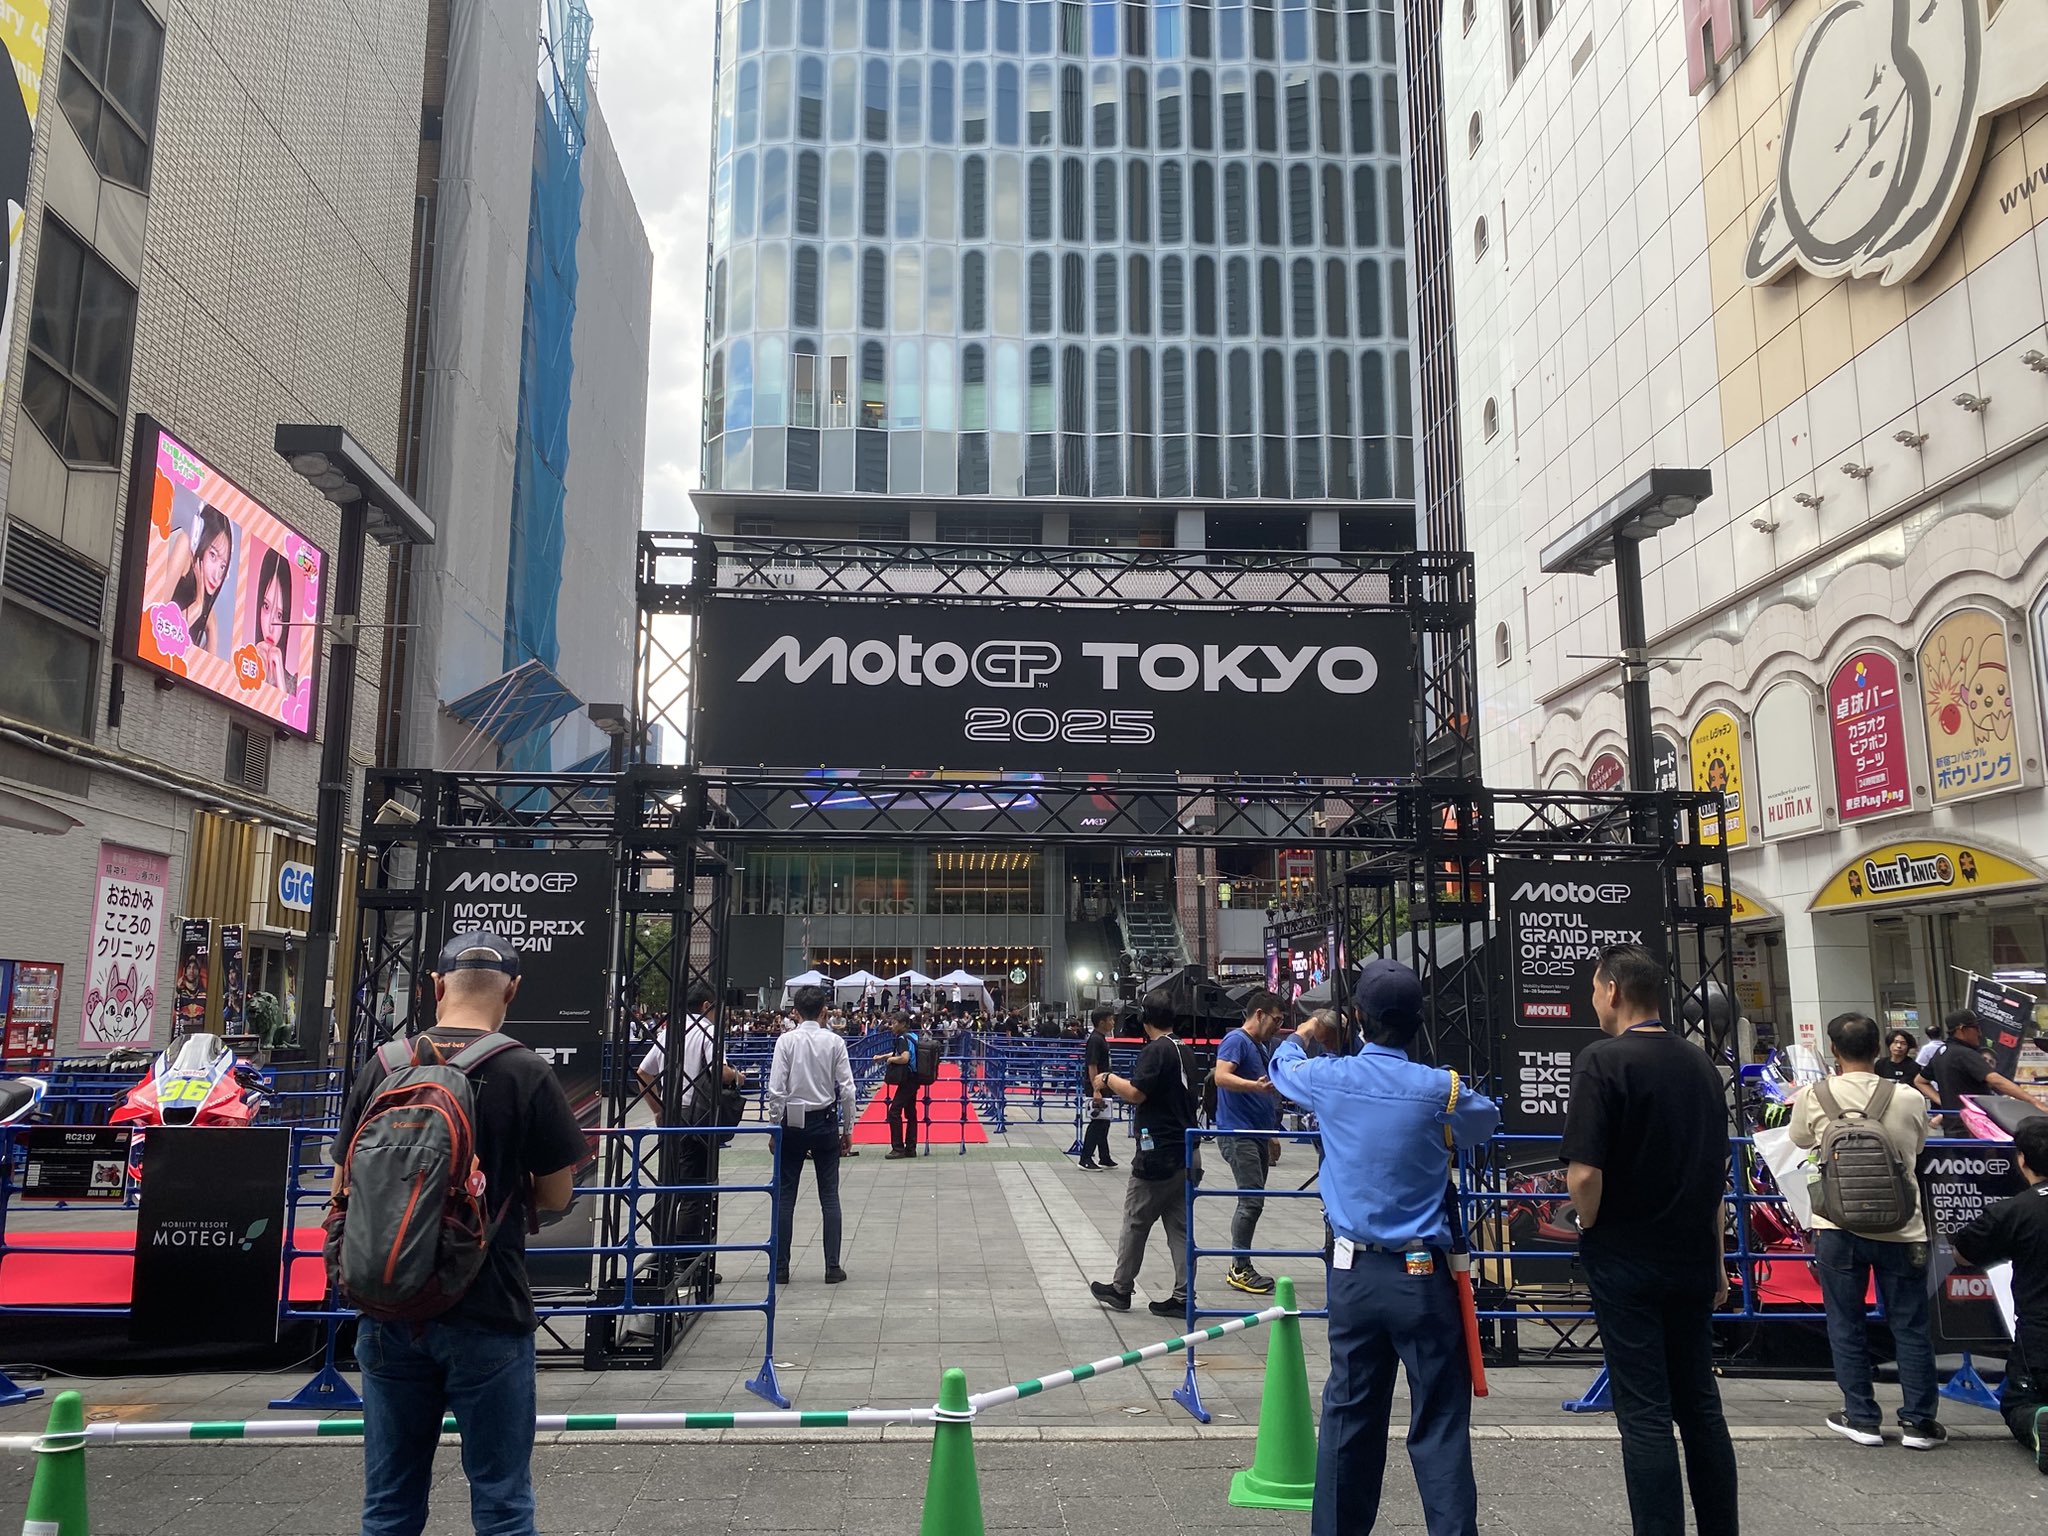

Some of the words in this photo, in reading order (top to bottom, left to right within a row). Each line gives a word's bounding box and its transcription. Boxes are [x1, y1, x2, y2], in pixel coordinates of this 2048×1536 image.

[157, 618, 184, 643] みちゃん
[241, 656, 258, 678] こほ
[736, 634, 1062, 688] MotoGP
[1082, 642, 1378, 694] TOKYO
[1836, 685, 1894, 720] 卓球バー
[964, 706, 1156, 744] 2025
[1848, 715, 1886, 740] カラオケ
[1856, 751, 1885, 772] ダーツ
[1938, 752, 2011, 790] ボウリング
[1767, 786, 1796, 799] wonderful
[1797, 784, 1811, 793] time
[1768, 797, 1813, 823] HUMAX
[1865, 862, 1900, 888] GAME
[1898, 857, 1937, 884] PANIC
[445, 871, 578, 893] MotoGP
[106, 883, 154, 911] おおかみ
[1510, 882, 1631, 903] MotoGP
[453, 903, 527, 918] MOTUL
[105, 912, 151, 935] こころの
[452, 920, 526, 935] GRAND
[529, 920, 585, 935] PRIX
[1520, 912, 1588, 928] MOTUL
[503, 936, 552, 951] PAN
[1520, 928, 1588, 944] GRAND
[1591, 930, 1643, 944] PRIX
[98, 936, 155, 961] クリニック
[1521, 944, 1546, 959] OF
[1521, 961, 1575, 976] 2025
[1525, 1005, 1569, 1016] MOTUL
[1518, 1051, 1572, 1066] THE
[157, 1079, 212, 1102] 36
[1521, 1099, 1557, 1114] ON
[65, 1133, 97, 1141] RC213V
[1924, 1158, 2011, 1175] MotoGP
[1931, 1183, 1982, 1195] MOTUL
[1933, 1196, 1982, 1208] GRAND
[1934, 1209, 1954, 1221] OF
[153, 1230, 234, 1246] MOTEGI
